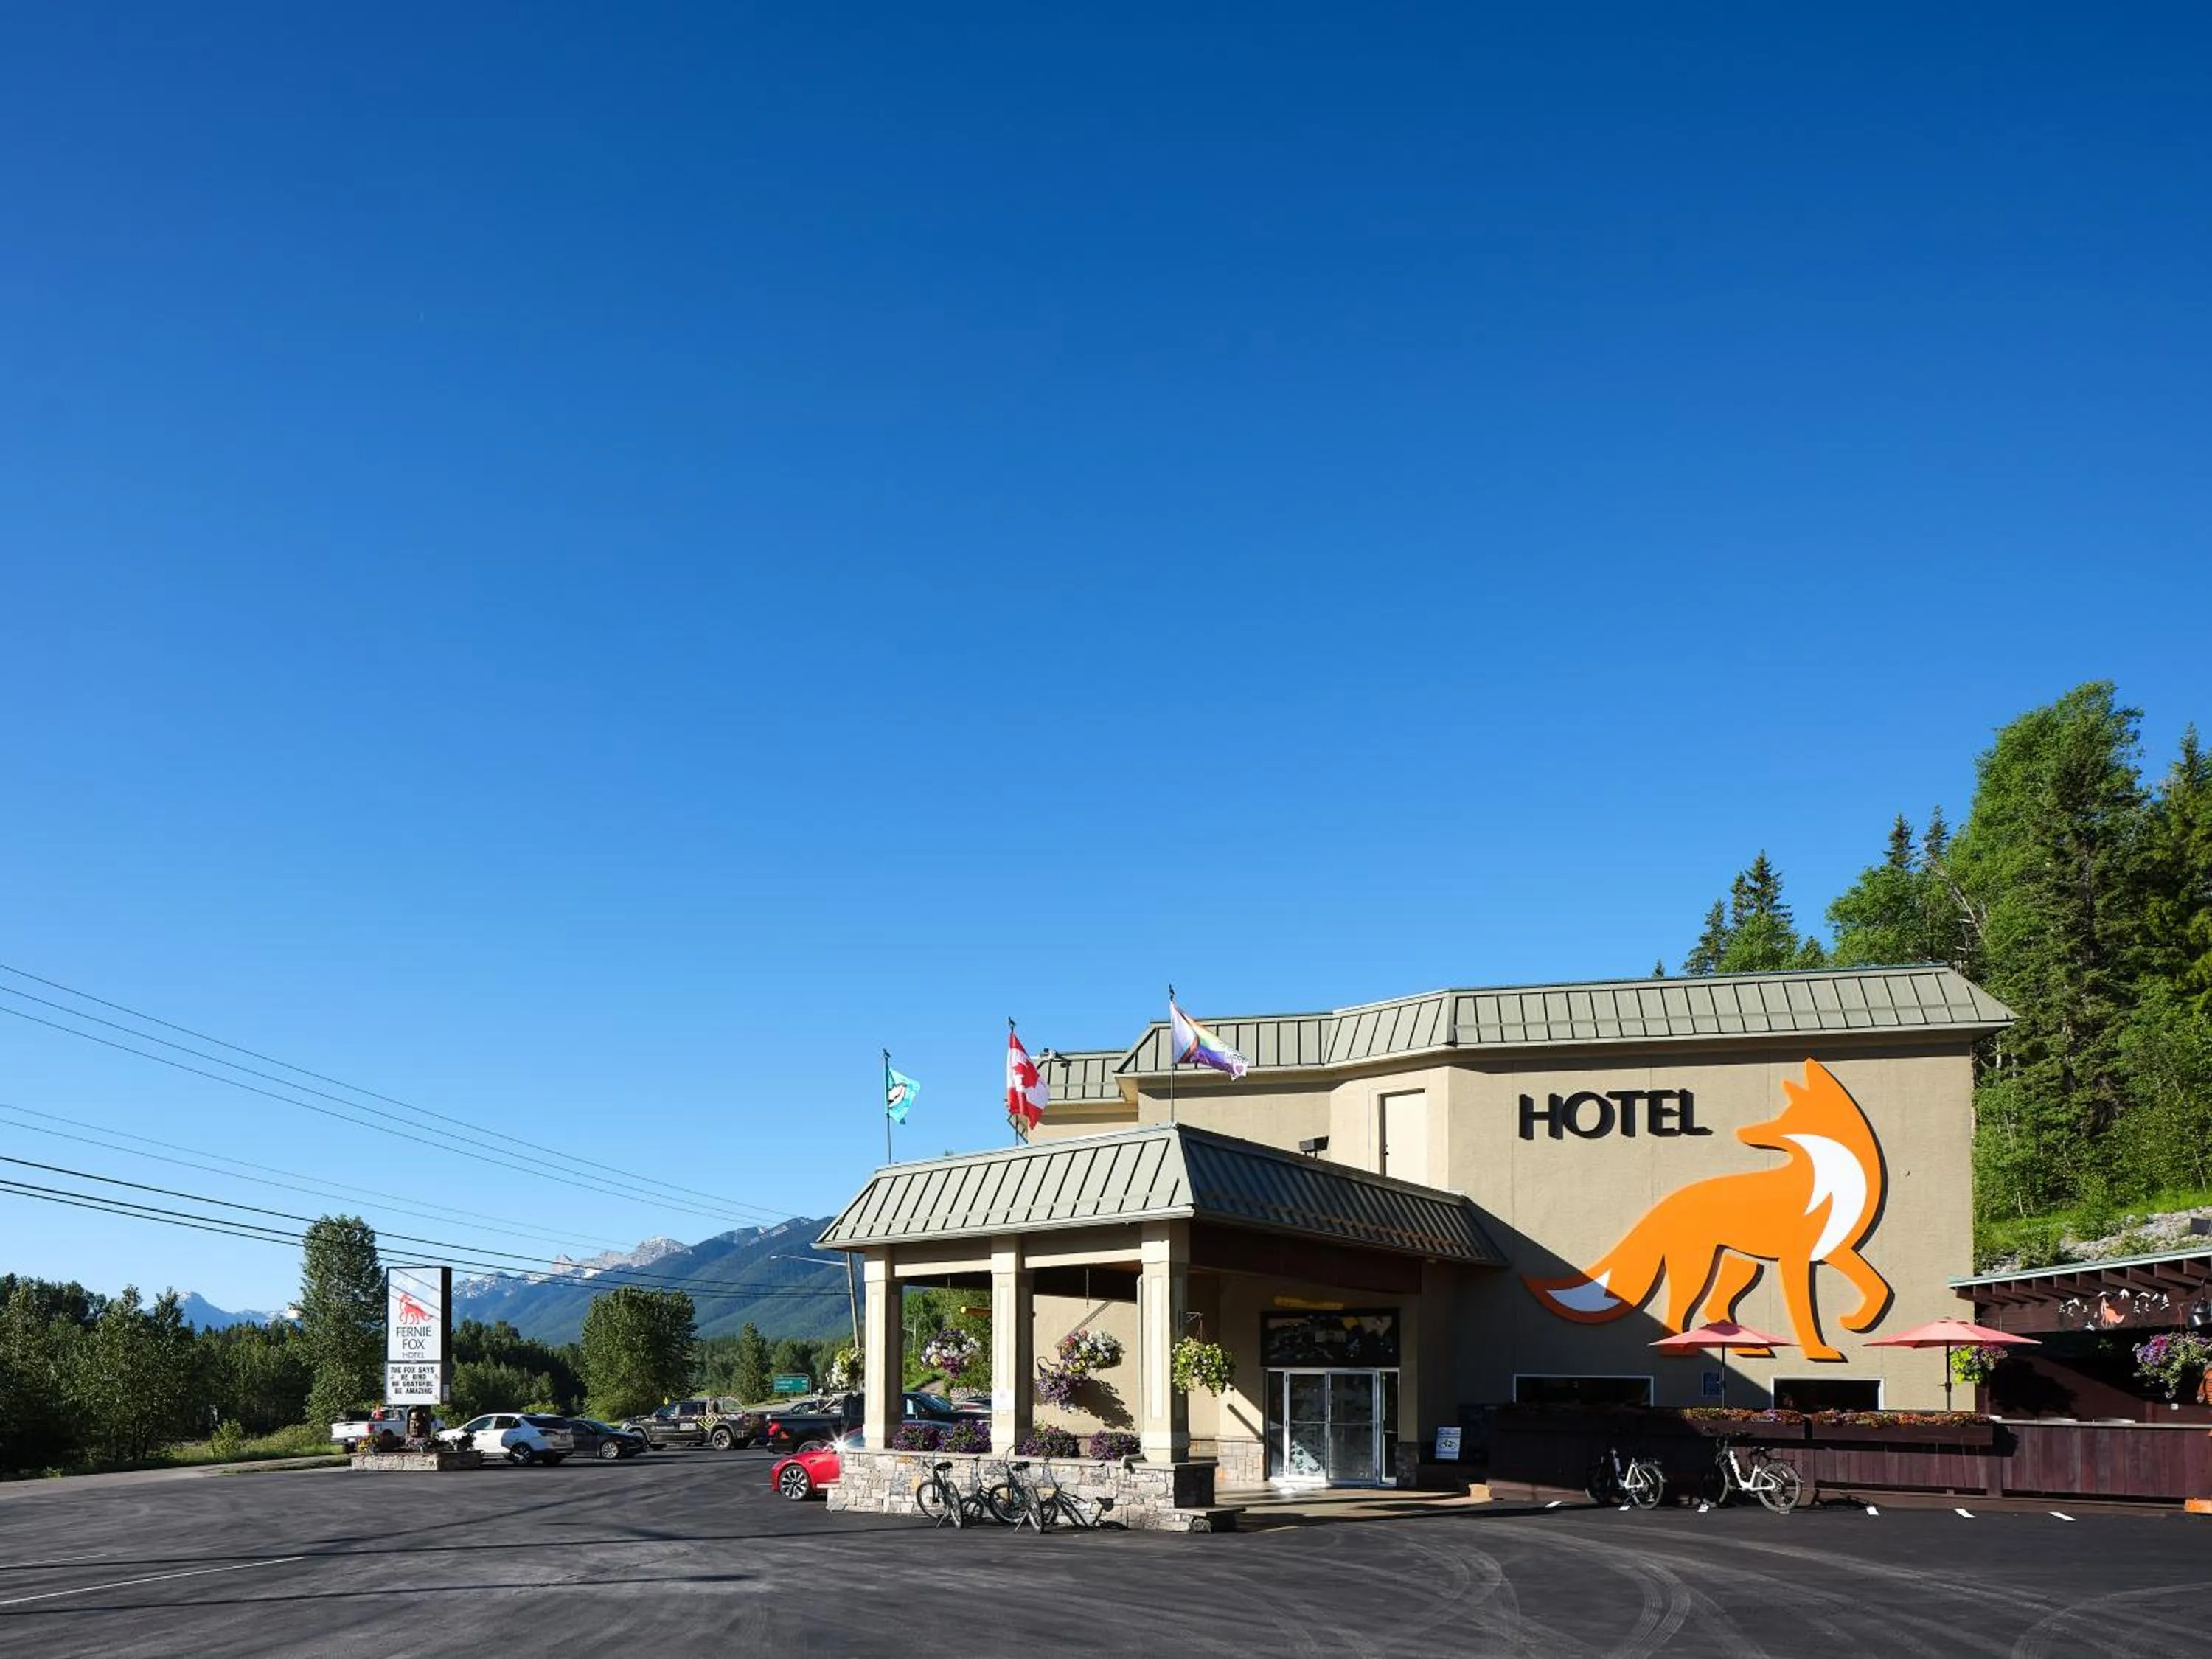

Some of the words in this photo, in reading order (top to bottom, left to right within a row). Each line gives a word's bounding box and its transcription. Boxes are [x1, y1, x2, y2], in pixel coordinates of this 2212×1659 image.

[1518, 1088, 1713, 1141] HOTEL
[396, 1326, 431, 1338] FERNIE
[402, 1338, 425, 1350] FOX
